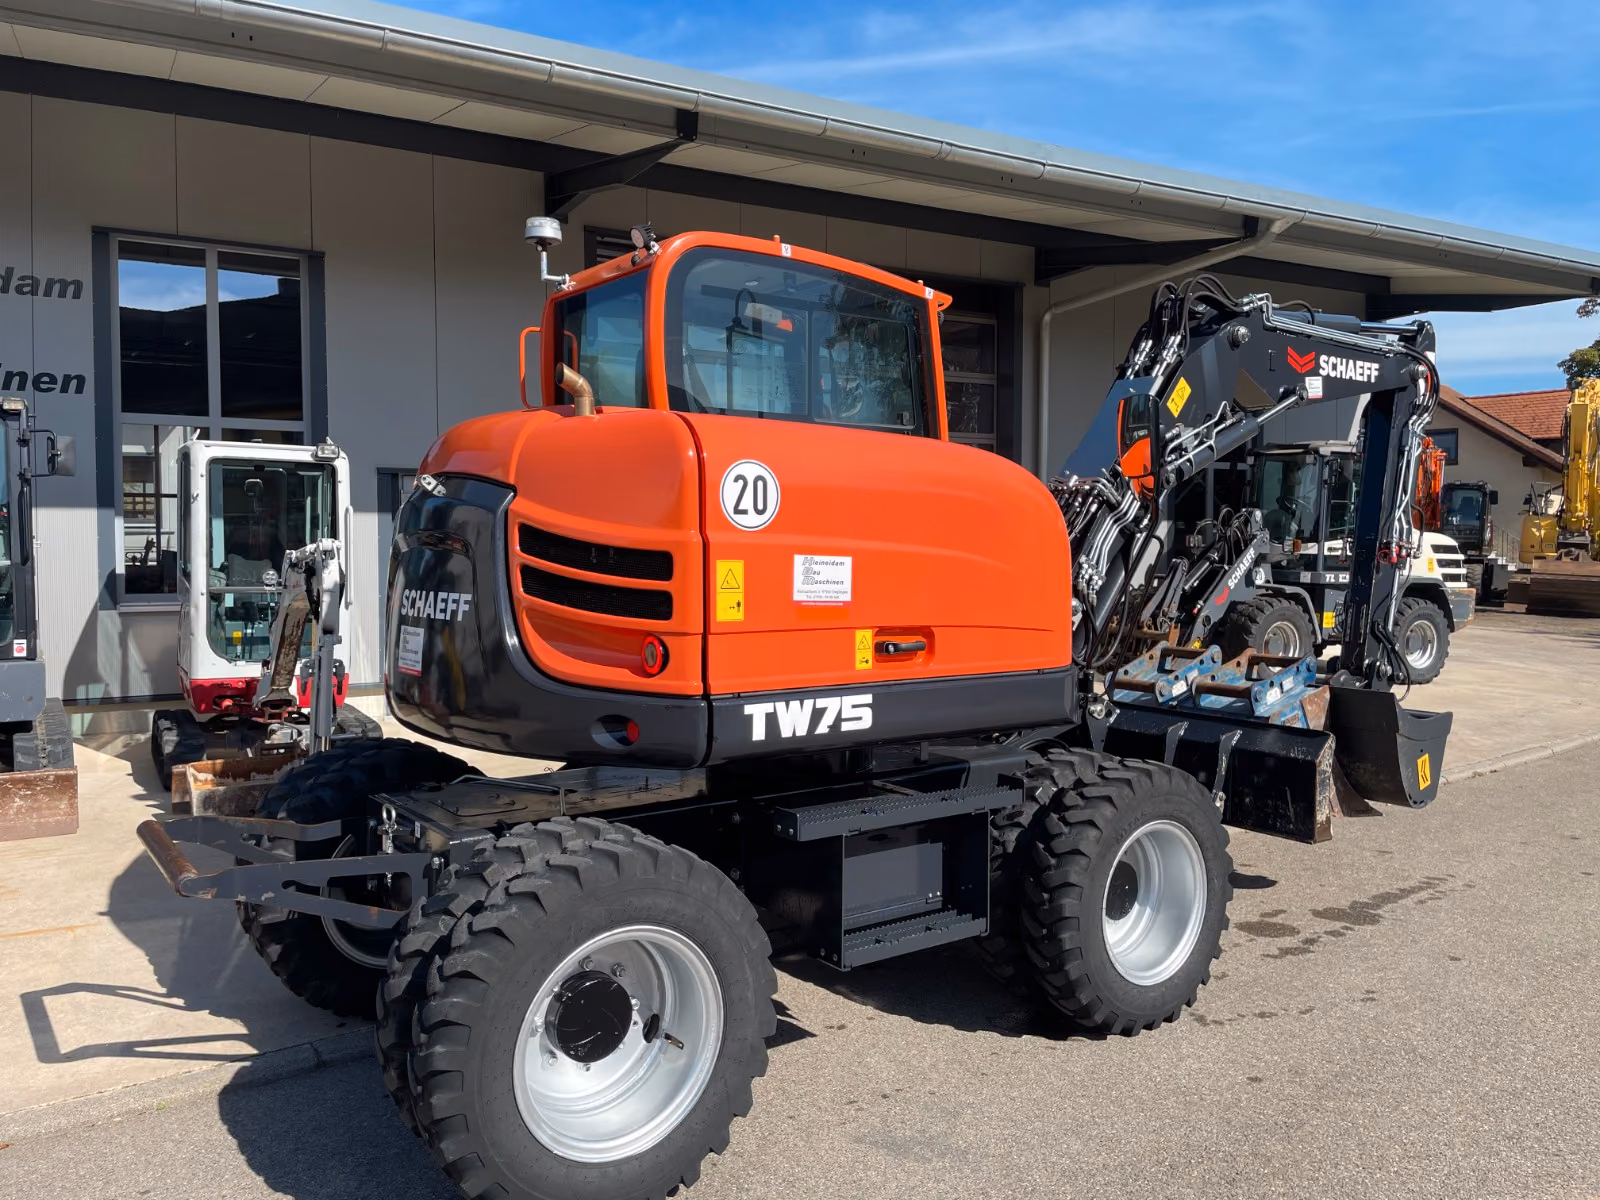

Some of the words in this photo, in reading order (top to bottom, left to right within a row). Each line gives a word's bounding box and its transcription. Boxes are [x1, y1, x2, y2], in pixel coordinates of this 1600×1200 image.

[0, 363, 87, 395] nen
[1319, 354, 1379, 383] SCHAEFF
[732, 473, 768, 516] 20
[801, 575, 844, 586] Maschinen
[1227, 547, 1255, 589] SCHAEFF
[400, 588, 472, 621] SCHAEFF
[743, 694, 873, 741] TW75
